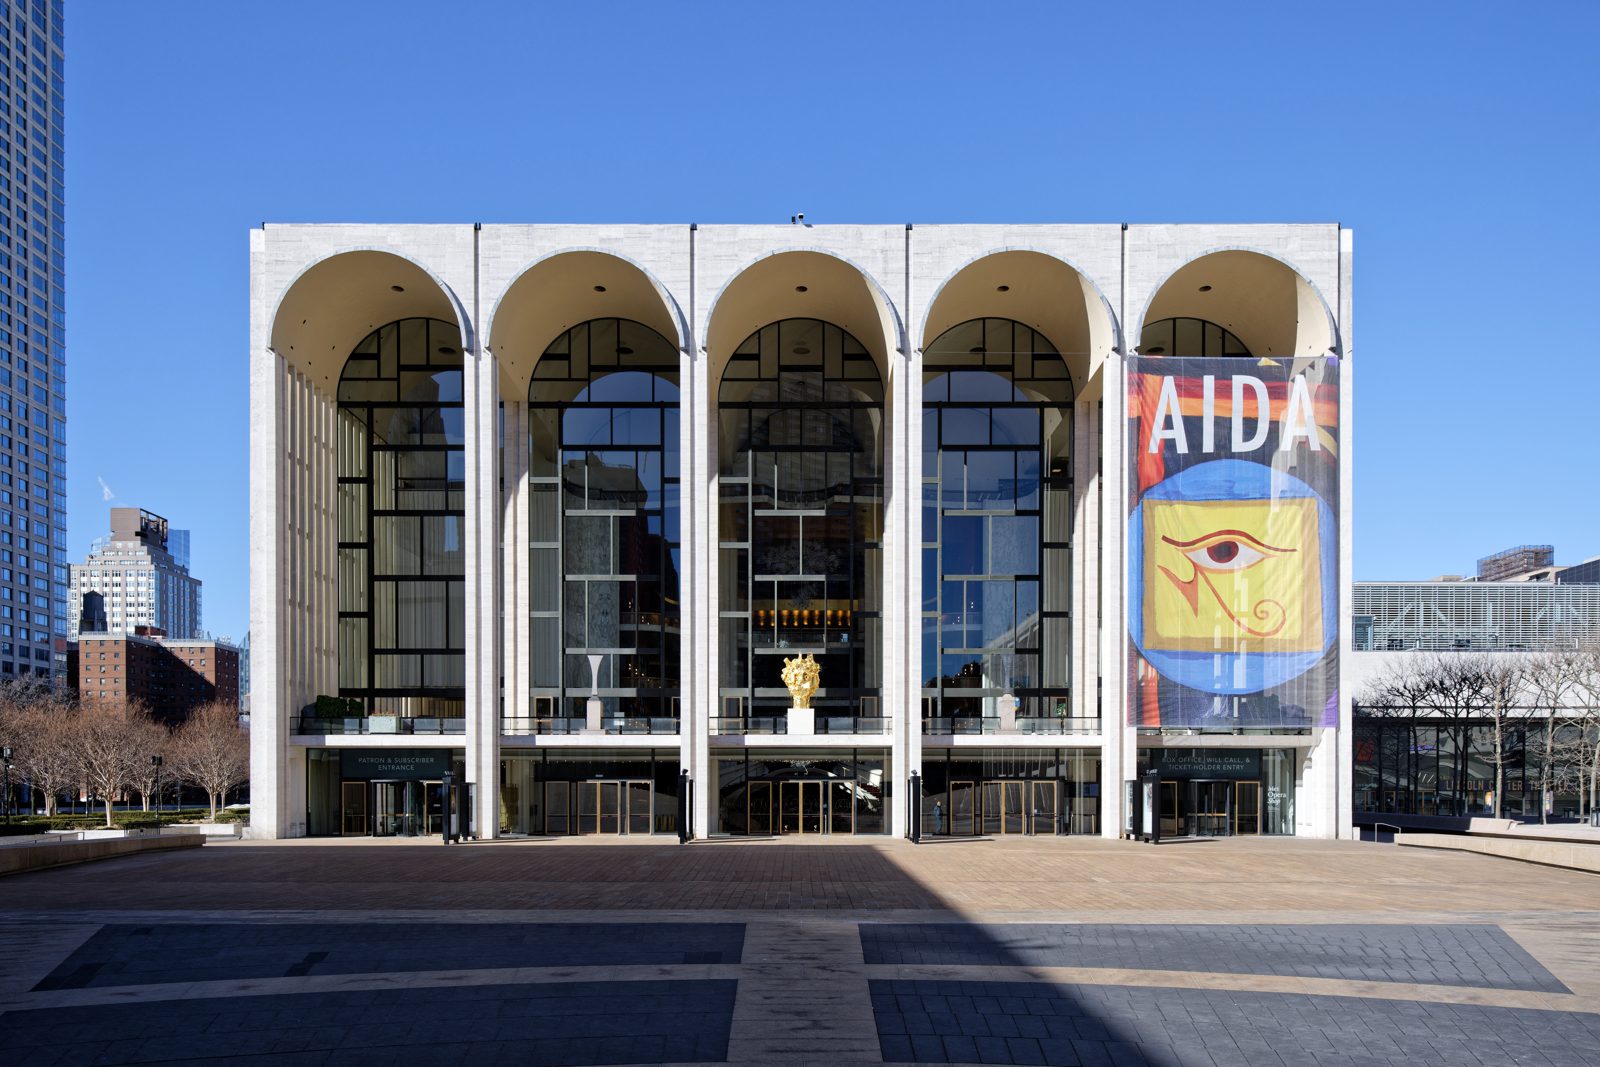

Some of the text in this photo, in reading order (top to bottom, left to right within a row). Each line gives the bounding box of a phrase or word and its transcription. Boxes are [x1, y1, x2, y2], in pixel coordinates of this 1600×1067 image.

[1148, 374, 1321, 454] AIDA
[1489, 780, 1523, 791] CTER
[1267, 791, 1286, 799] Opera
